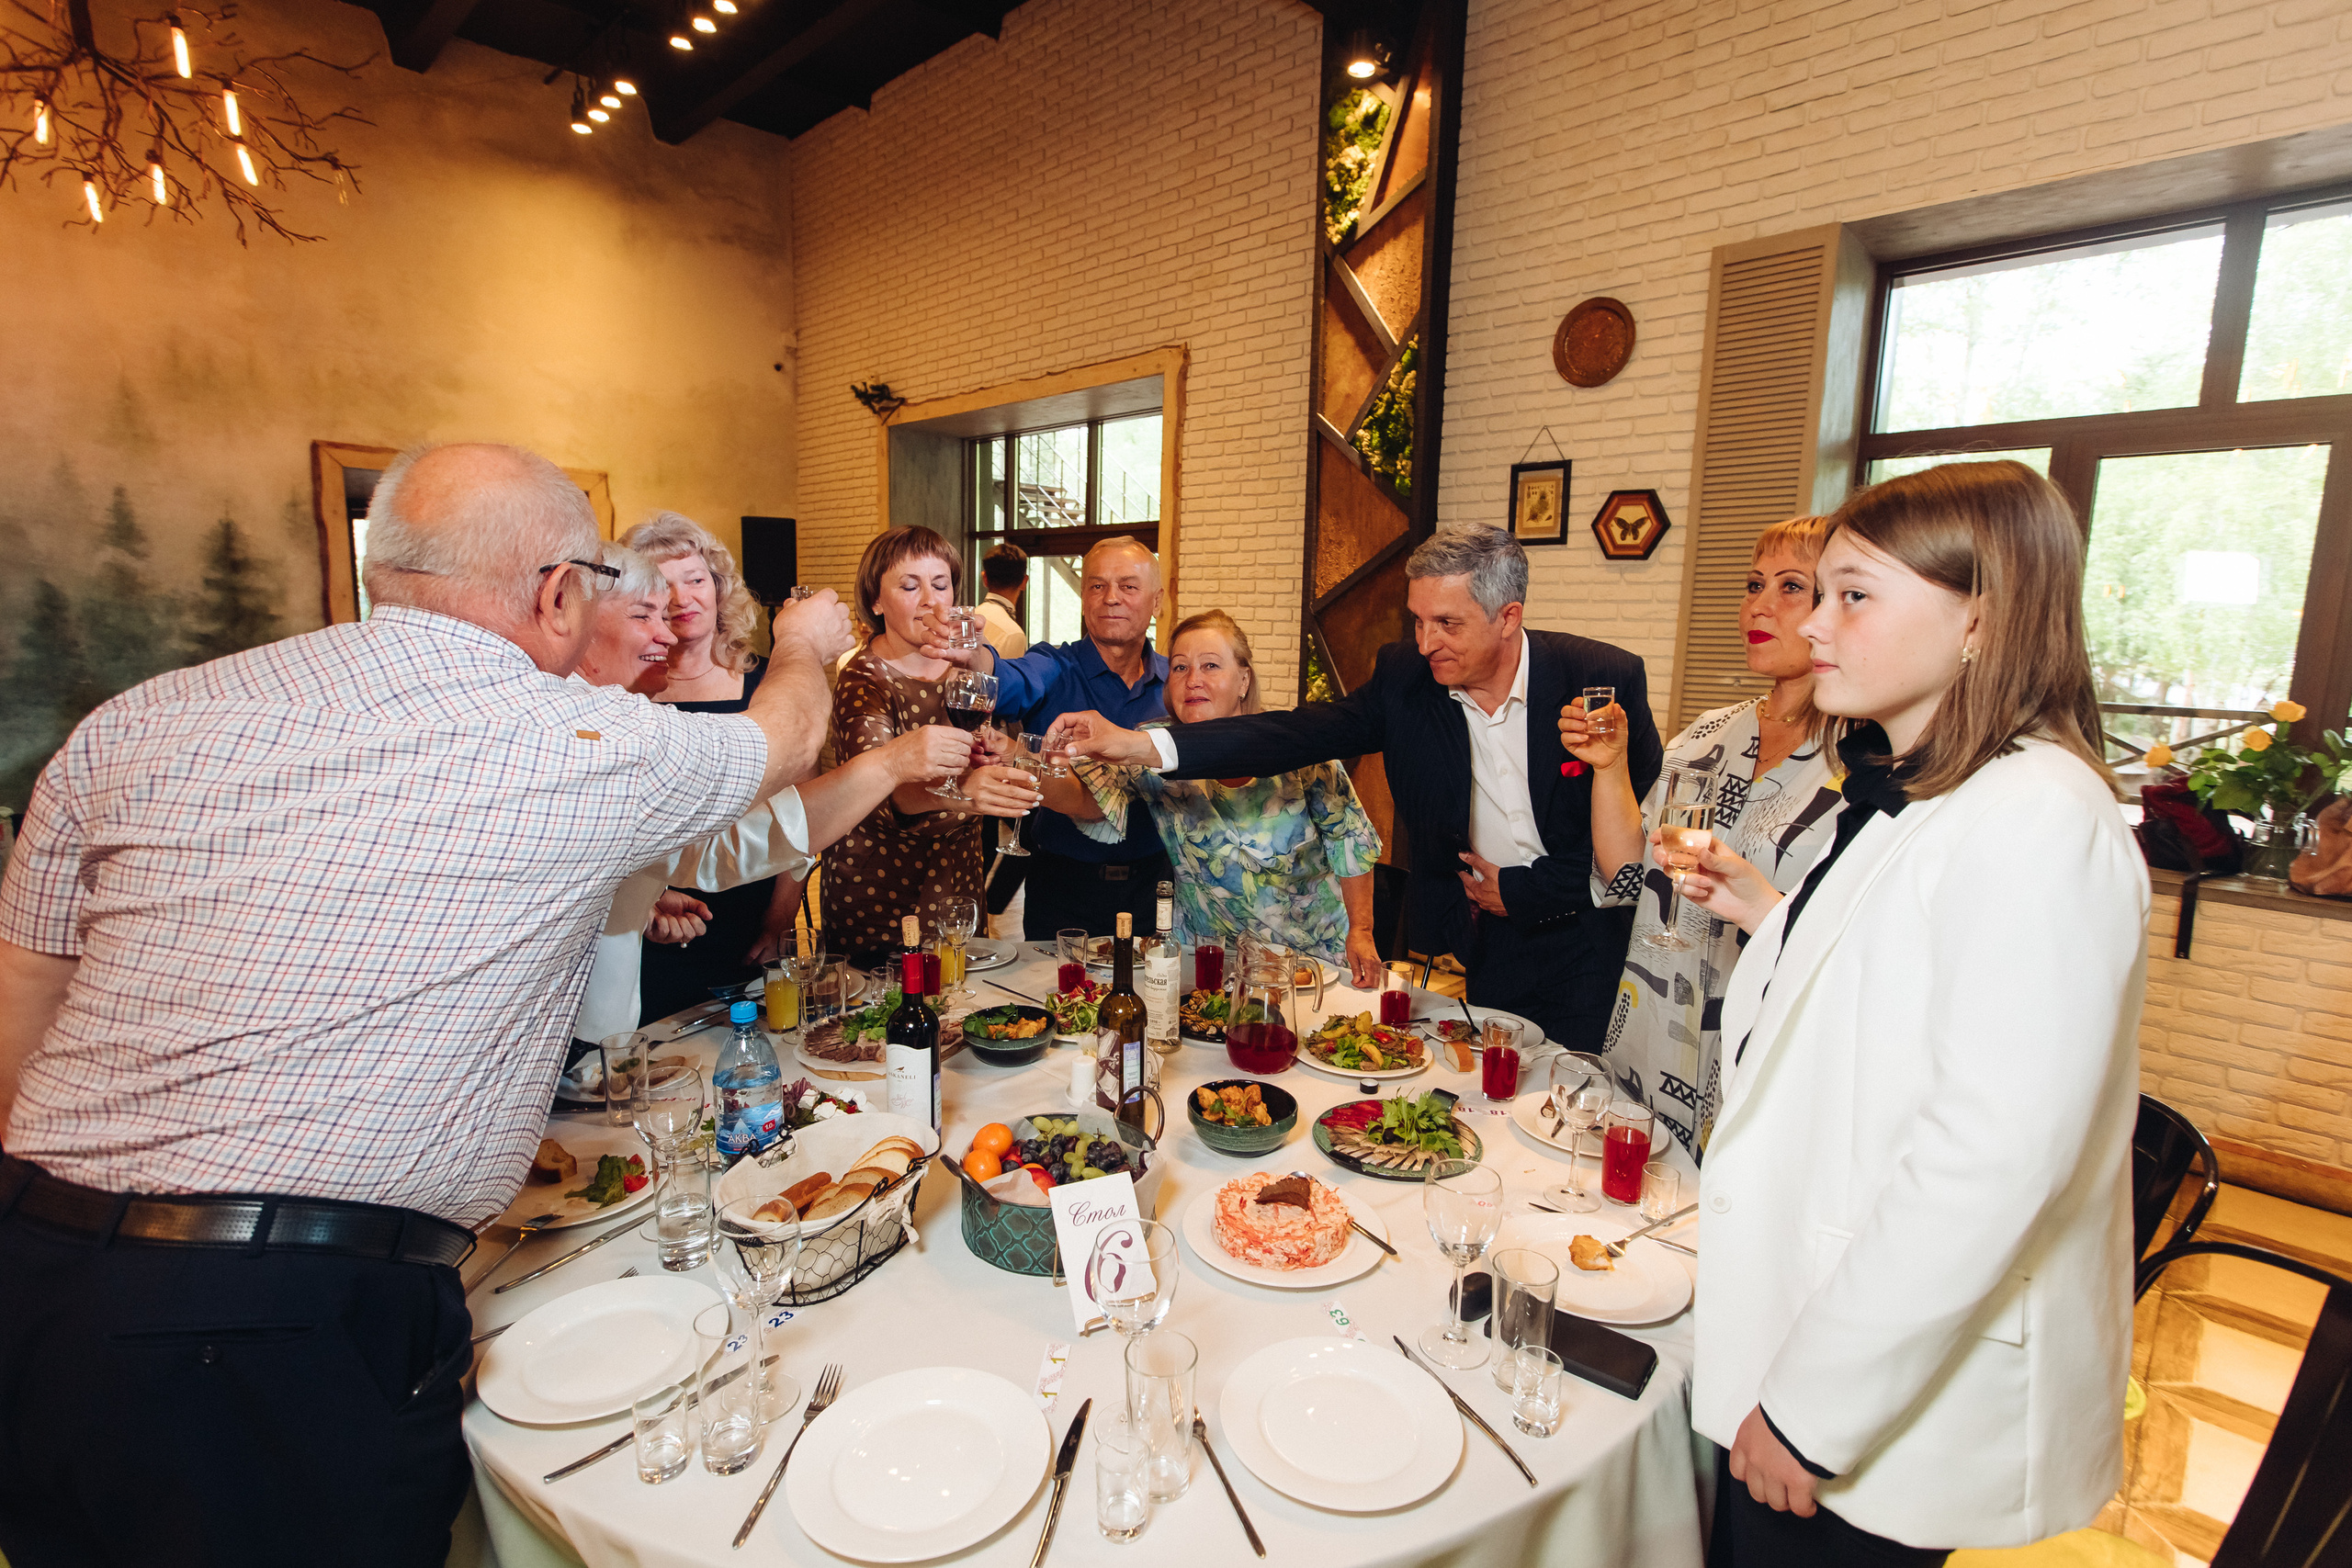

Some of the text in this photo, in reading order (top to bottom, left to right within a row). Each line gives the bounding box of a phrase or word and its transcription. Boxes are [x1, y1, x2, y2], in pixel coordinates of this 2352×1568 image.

[1068, 1201, 1126, 1227] Стол
[1084, 1230, 1134, 1303] 6
[768, 1311, 794, 1328] 23
[1329, 1309, 1350, 1325] 63
[727, 1334, 748, 1352] 23
